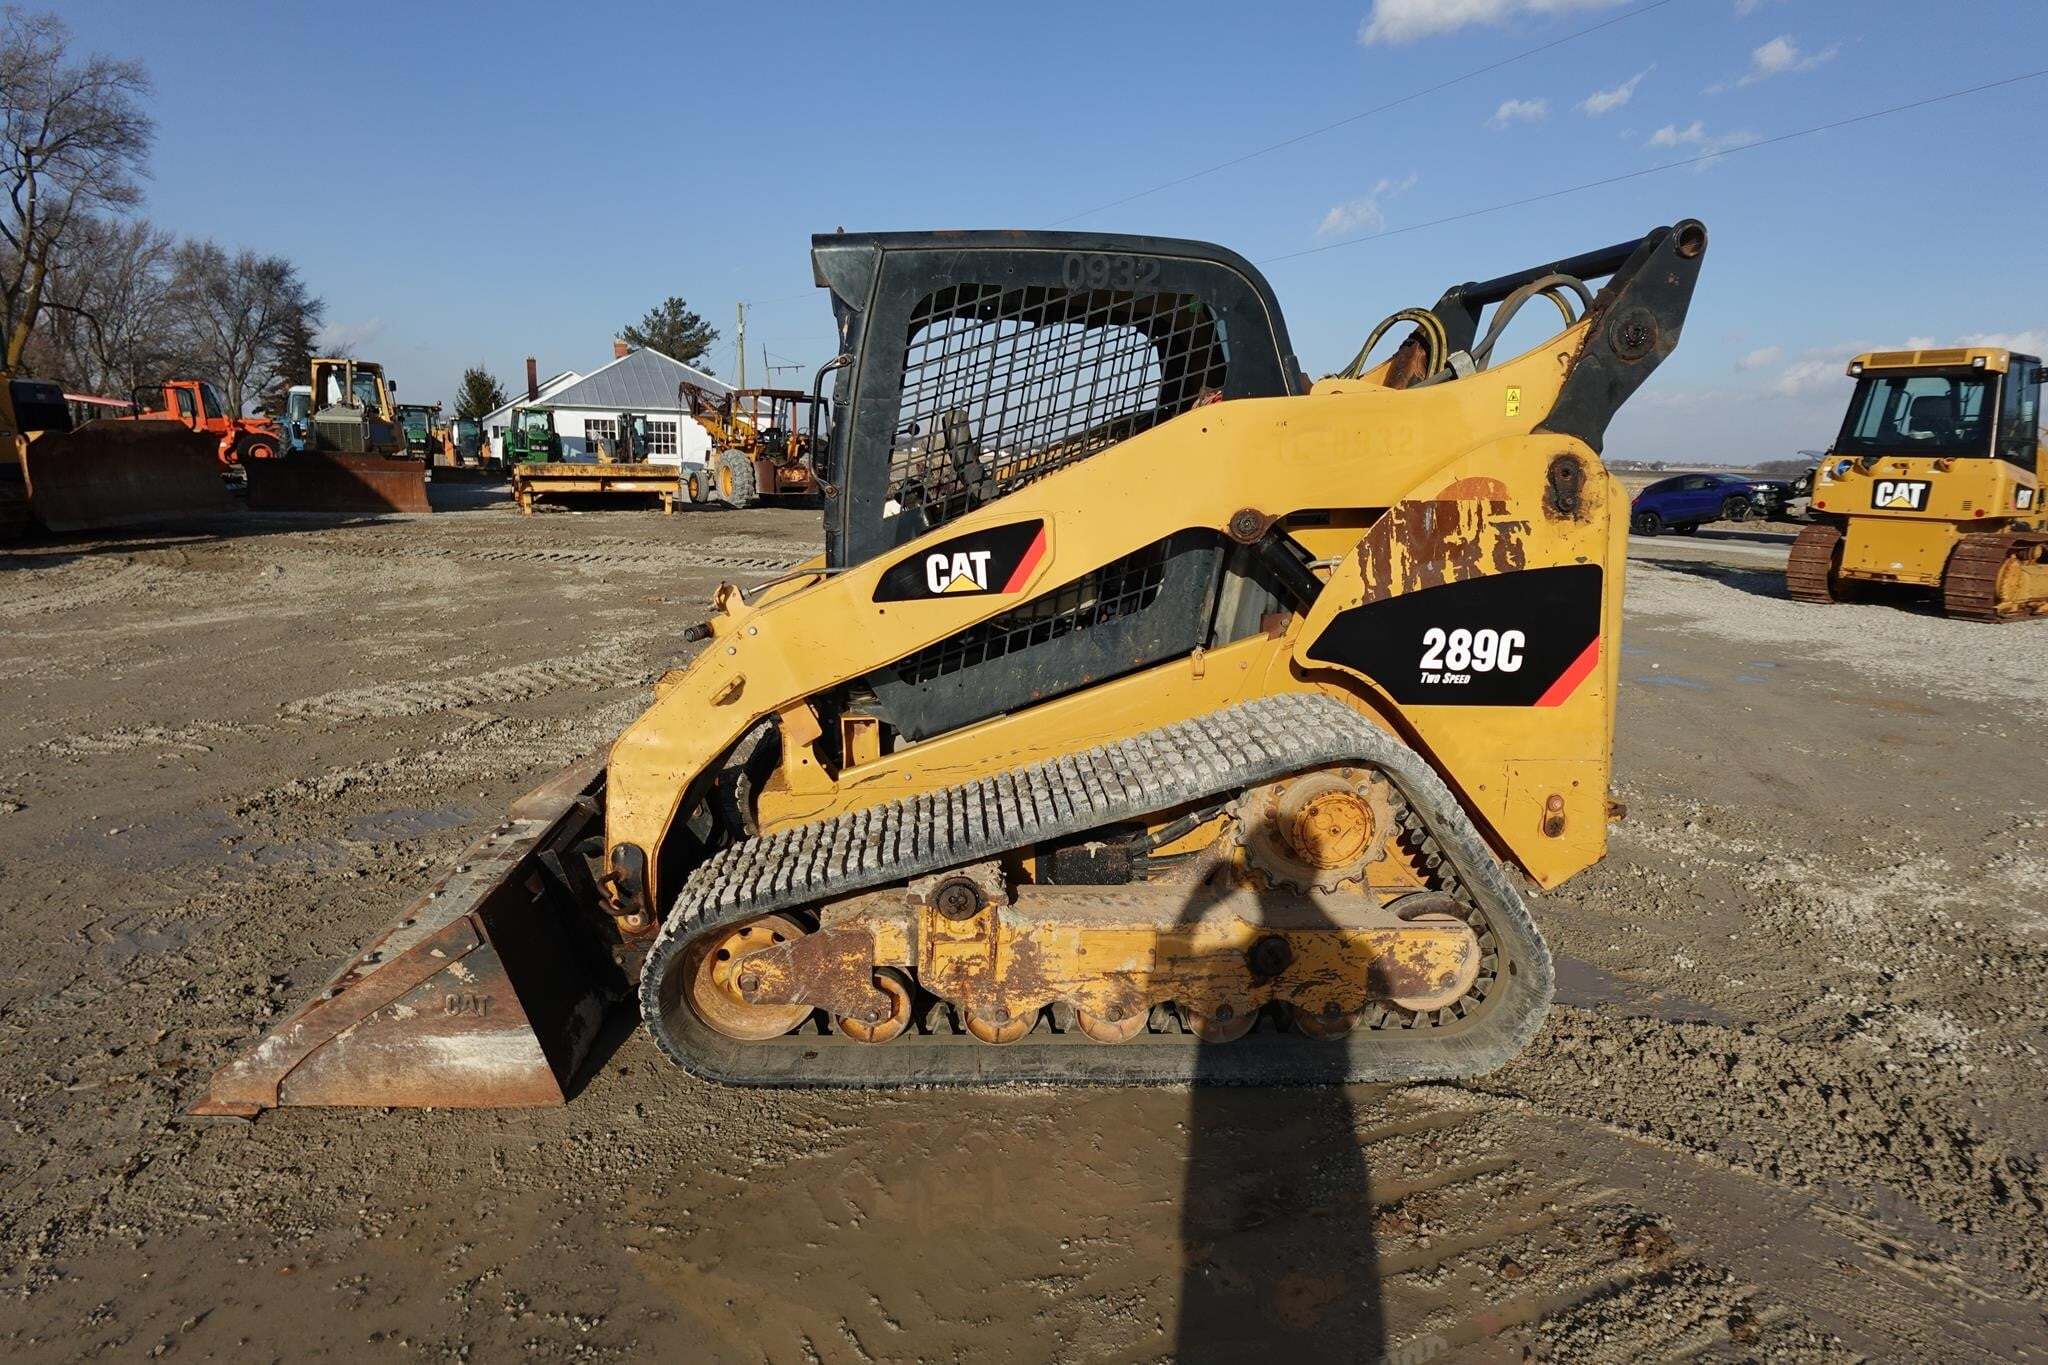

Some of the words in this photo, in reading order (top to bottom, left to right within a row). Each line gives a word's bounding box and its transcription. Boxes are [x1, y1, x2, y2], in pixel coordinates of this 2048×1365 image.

[1062, 253, 1160, 290] 0932
[1875, 482, 1926, 508] CAT
[926, 551, 991, 593] CAT
[1419, 627, 1526, 672] 289C
[444, 993, 492, 1018] CAT
